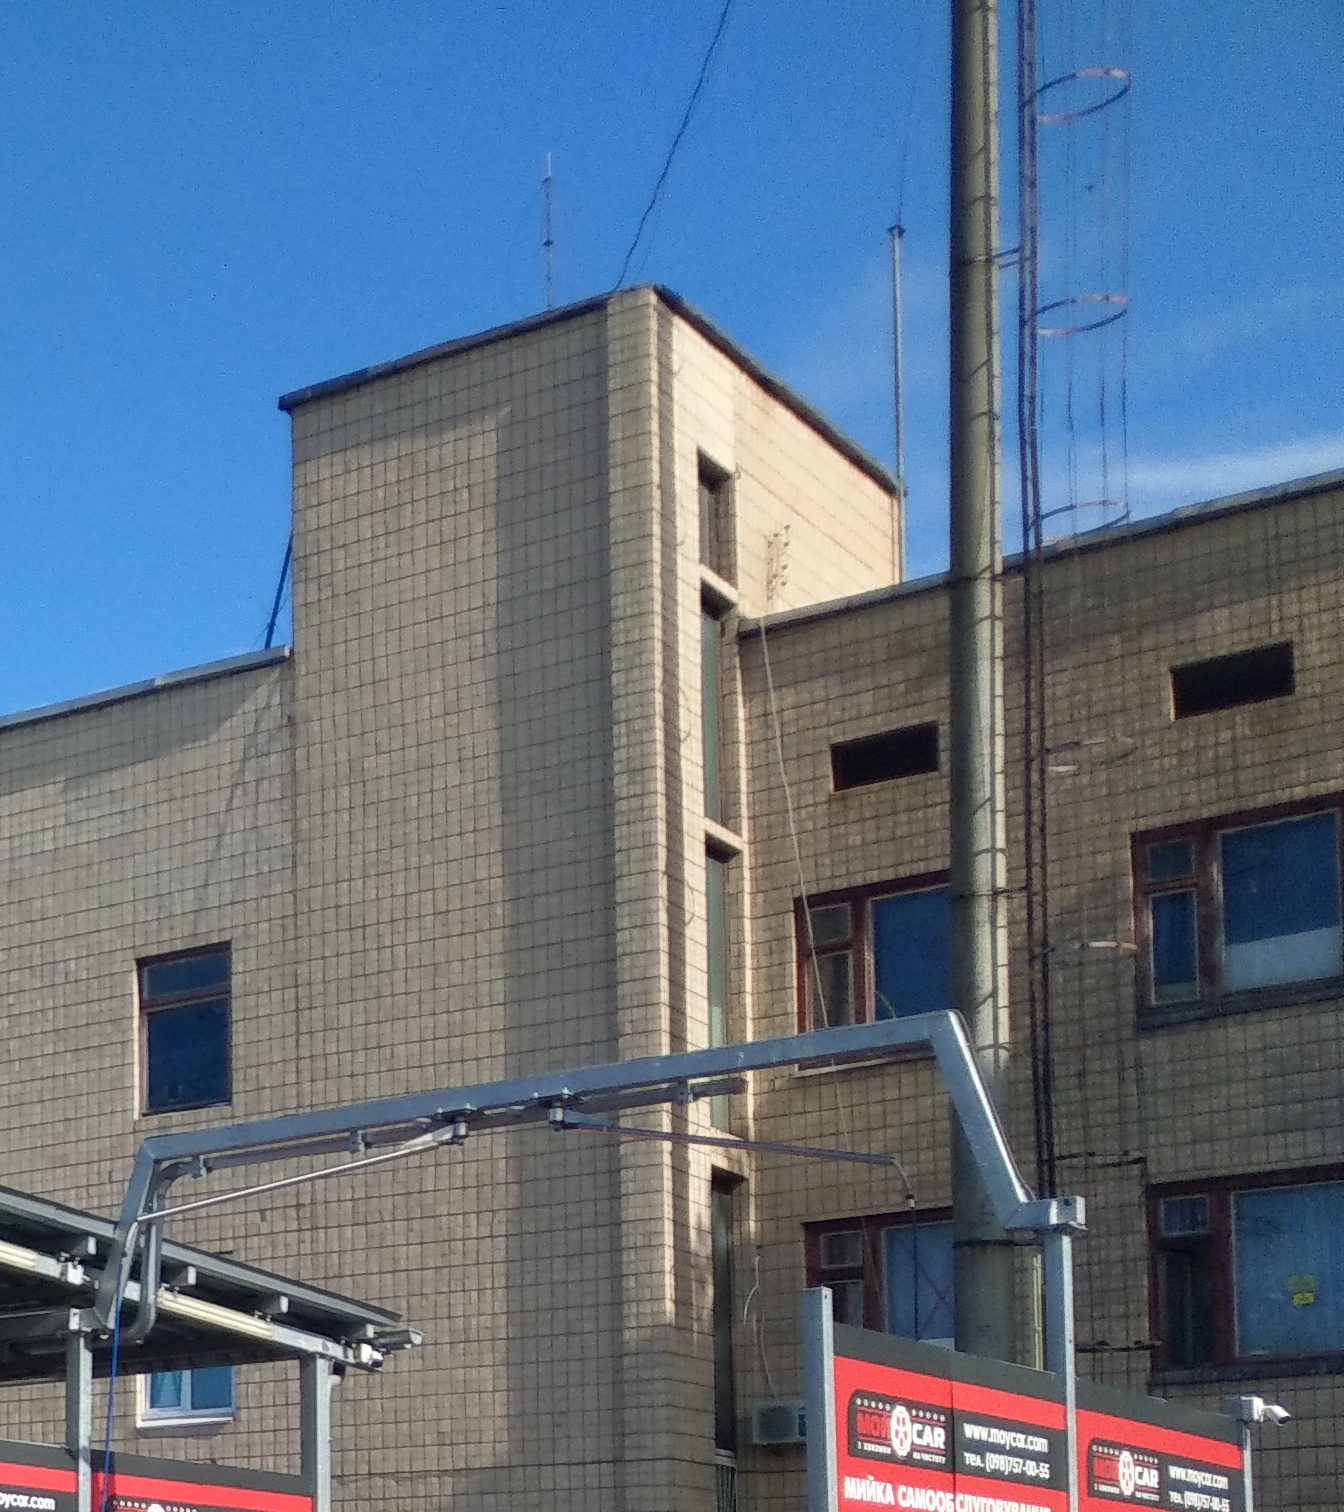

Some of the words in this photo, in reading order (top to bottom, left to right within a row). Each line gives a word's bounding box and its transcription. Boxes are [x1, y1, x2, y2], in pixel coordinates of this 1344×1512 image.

[912, 1423, 945, 1449] CAR
[963, 1423, 1048, 1452] www.moycar.com
[964, 1452, 984, 1466] тел.
[986, 1454, 1050, 1479] (098)757-00-55
[1135, 1466, 1159, 1488] CAR
[844, 1475, 895, 1506] МИЙКА
